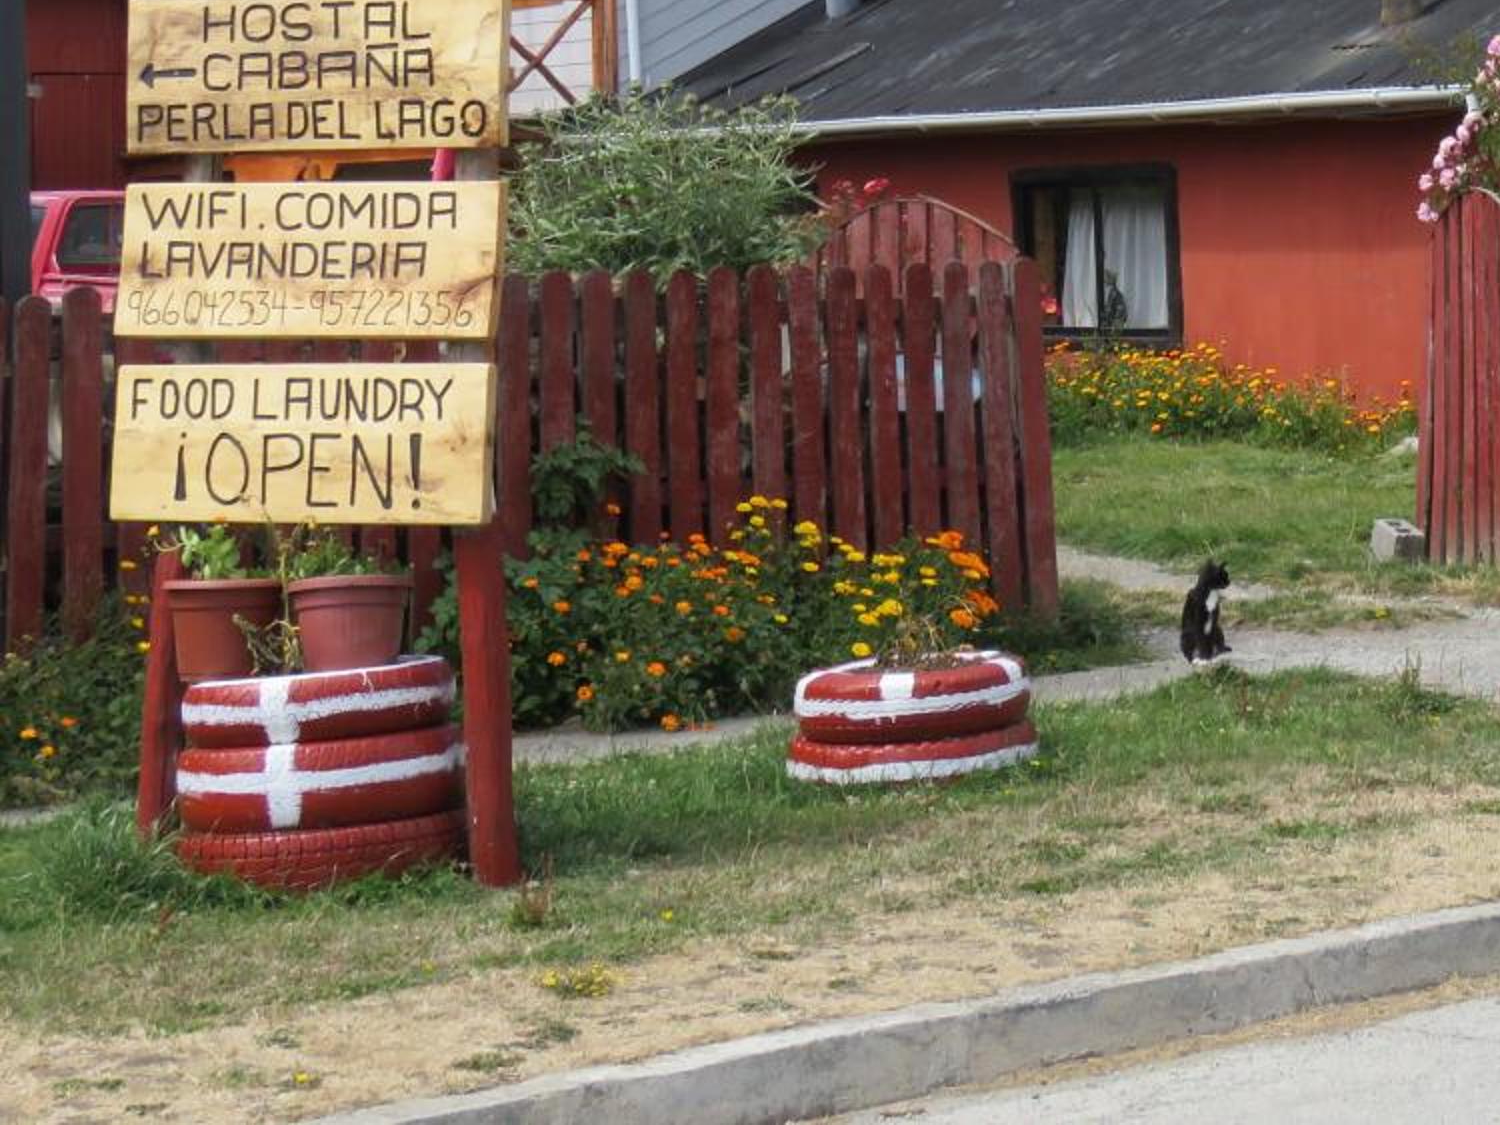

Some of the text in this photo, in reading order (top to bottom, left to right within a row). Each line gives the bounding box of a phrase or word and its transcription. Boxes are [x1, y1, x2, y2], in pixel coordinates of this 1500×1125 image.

[202, 0, 431, 42] HOSTAL
[202, 43, 434, 92] CABAÑA
[137, 99, 487, 142] PERLA DEL LAGO
[139, 240, 427, 280] LAVANDERIA
[131, 377, 454, 421] FOOD LAUNDRY
